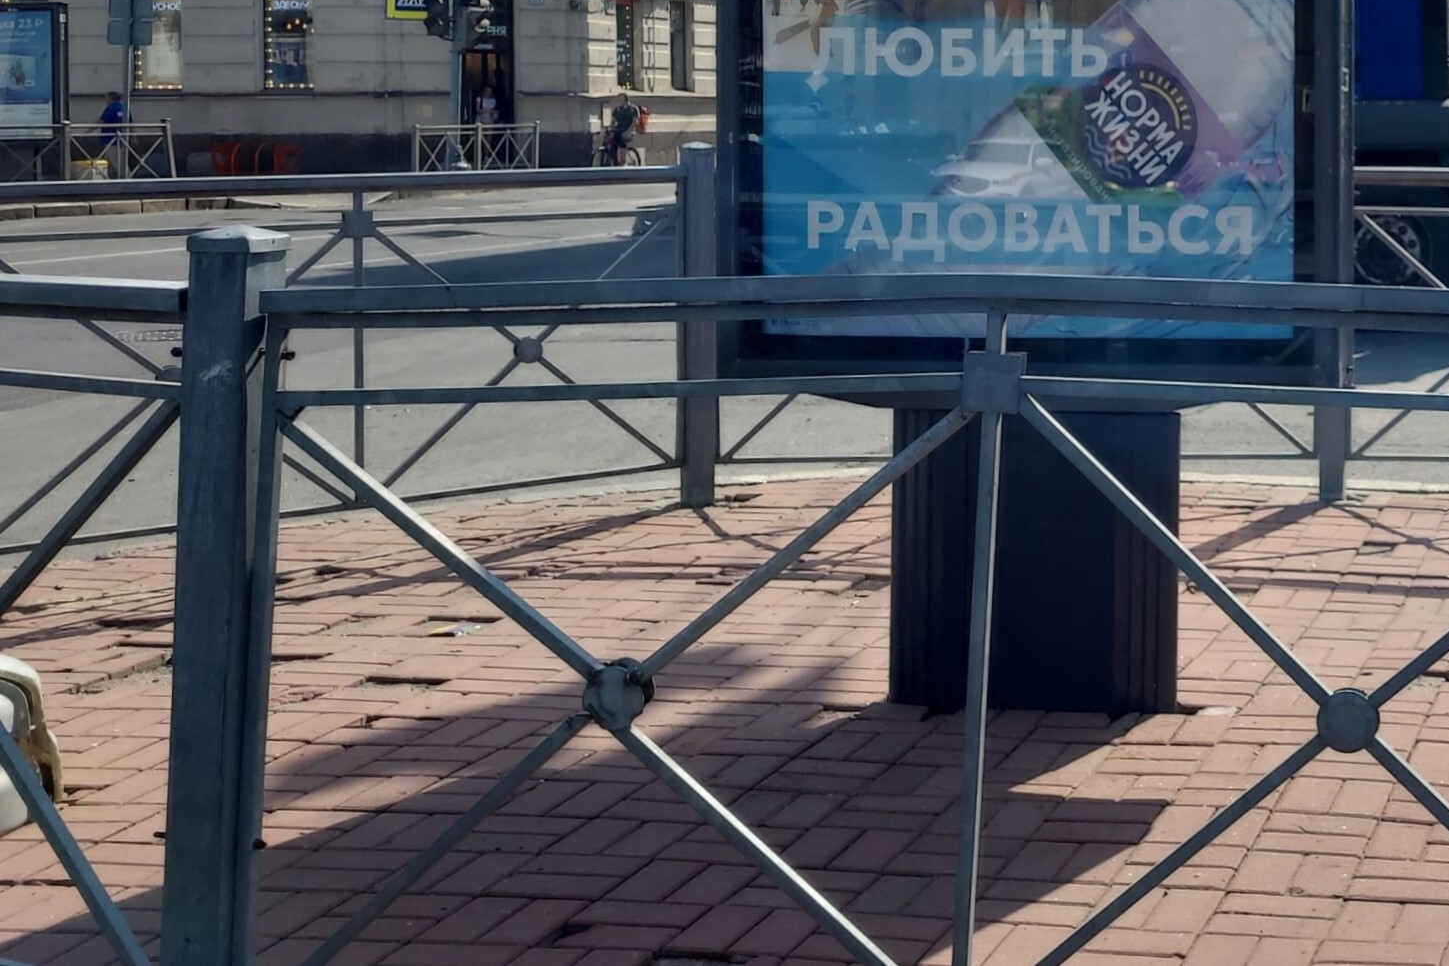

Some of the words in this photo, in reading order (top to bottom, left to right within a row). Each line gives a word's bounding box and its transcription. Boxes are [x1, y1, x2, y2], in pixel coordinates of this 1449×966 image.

[813, 27, 1108, 78] ЛЮБИТЬ
[1084, 90, 1168, 185] ЖИЗНИ
[1104, 71, 1184, 165] НОРМА
[806, 201, 1254, 263] РАДОВАТЬСЯ
